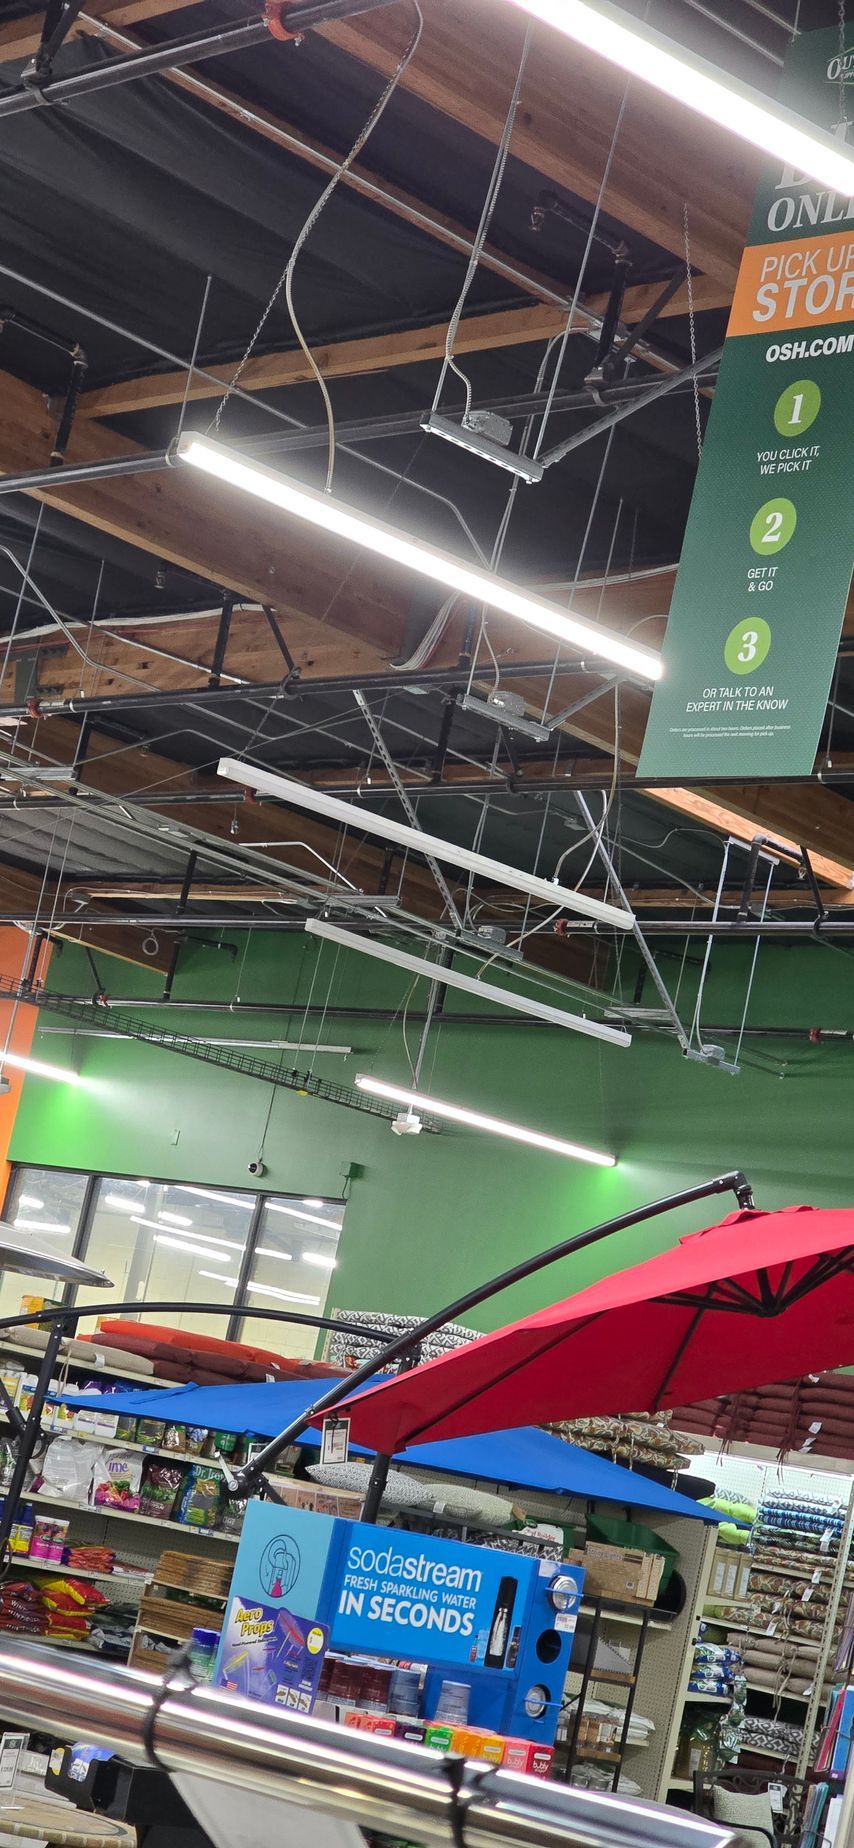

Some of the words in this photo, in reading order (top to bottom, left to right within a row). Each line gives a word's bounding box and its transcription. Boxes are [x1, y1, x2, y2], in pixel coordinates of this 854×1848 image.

[827, 55, 854, 80] OU
[760, 249, 821, 282] PICK
[766, 334, 854, 362] OSH.COM
[788, 394, 803, 424] 1
[757, 450, 777, 462] YOU
[779, 447, 807, 460] CLICK
[810, 446, 820, 458] IT,
[760, 463, 774, 475] WE
[777, 461, 800, 473] PICK
[802, 459, 812, 471] IT
[762, 512, 783, 543] 2
[747, 567, 767, 579] GET
[768, 567, 778, 577] IT
[748, 582, 755, 592] &
[758, 580, 773, 591] GO
[738, 631, 758, 662] 3
[703, 688, 717, 698] OR
[719, 687, 742, 698] TALK
[744, 687, 757, 697] TO
[758, 686, 774, 696] AN
[686, 701, 722, 712] EXPERT
[723, 701, 733, 711] IN
[735, 700, 756, 711] THE
[756, 699, 789, 710] KNOW
[347, 1546, 482, 1592] sodastream
[344, 1574, 379, 1591] FRESH
[380, 1581, 438, 1603] SPARKLING
[441, 1591, 477, 1610] WATER
[235, 1608, 262, 1623] Aero
[338, 1589, 364, 1617] IN
[367, 1595, 475, 1636] SECONDS
[241, 1620, 274, 1638] Props
